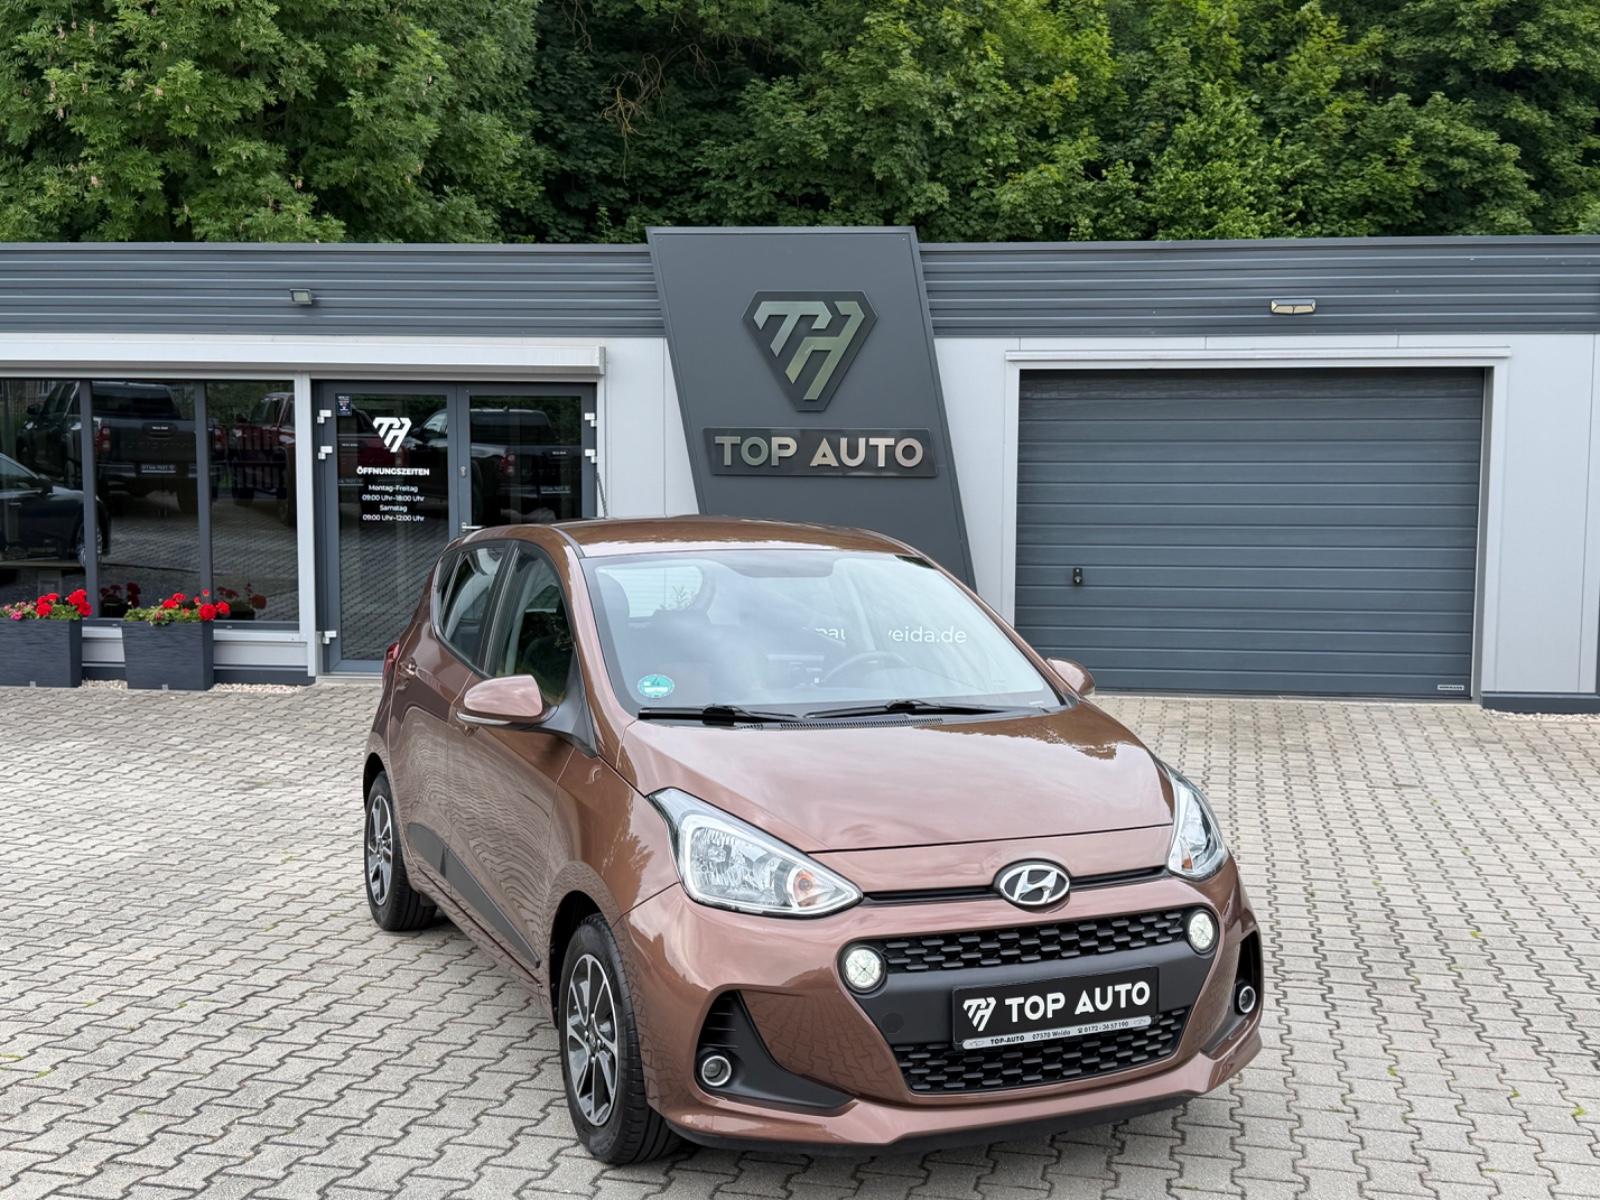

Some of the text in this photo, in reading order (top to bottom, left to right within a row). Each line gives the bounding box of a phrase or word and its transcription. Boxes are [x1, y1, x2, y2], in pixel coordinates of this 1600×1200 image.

[714, 435, 924, 468] TOP AUTO
[356, 466, 430, 476] ÖFFNUNGSZEITEN
[368, 484, 419, 493] Montag-Freitag
[379, 504, 408, 513] Samstag
[1004, 981, 1151, 1023] TOP AUTO
[990, 1035, 1025, 1045] TOP-AUTO
